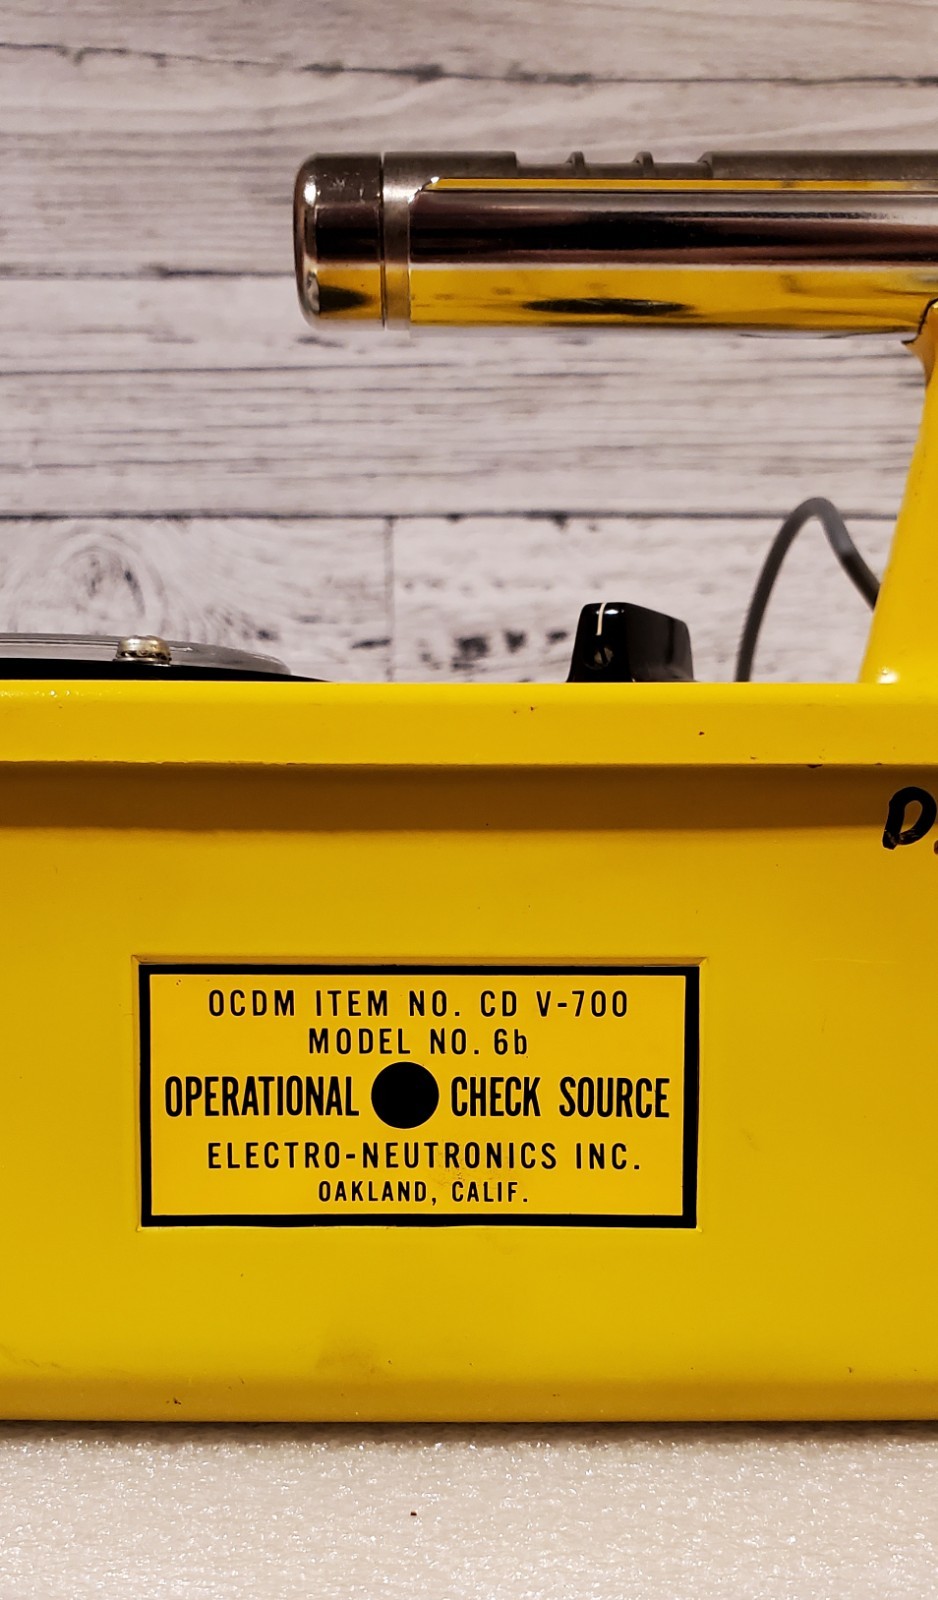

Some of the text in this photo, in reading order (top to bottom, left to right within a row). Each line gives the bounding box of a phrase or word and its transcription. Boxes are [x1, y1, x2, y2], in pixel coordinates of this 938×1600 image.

[209, 990, 627, 1017] OCDM ITEM NO. CD V-700
[309, 1028, 526, 1055] MODEL NO. 6b
[165, 1076, 669, 1118] OPERATIONAL CHECK SOURCE
[208, 1142, 639, 1169] ELECTRO-NEUTRONICS INC.
[319, 1181, 527, 1205] OAKLAND, CALIF.
